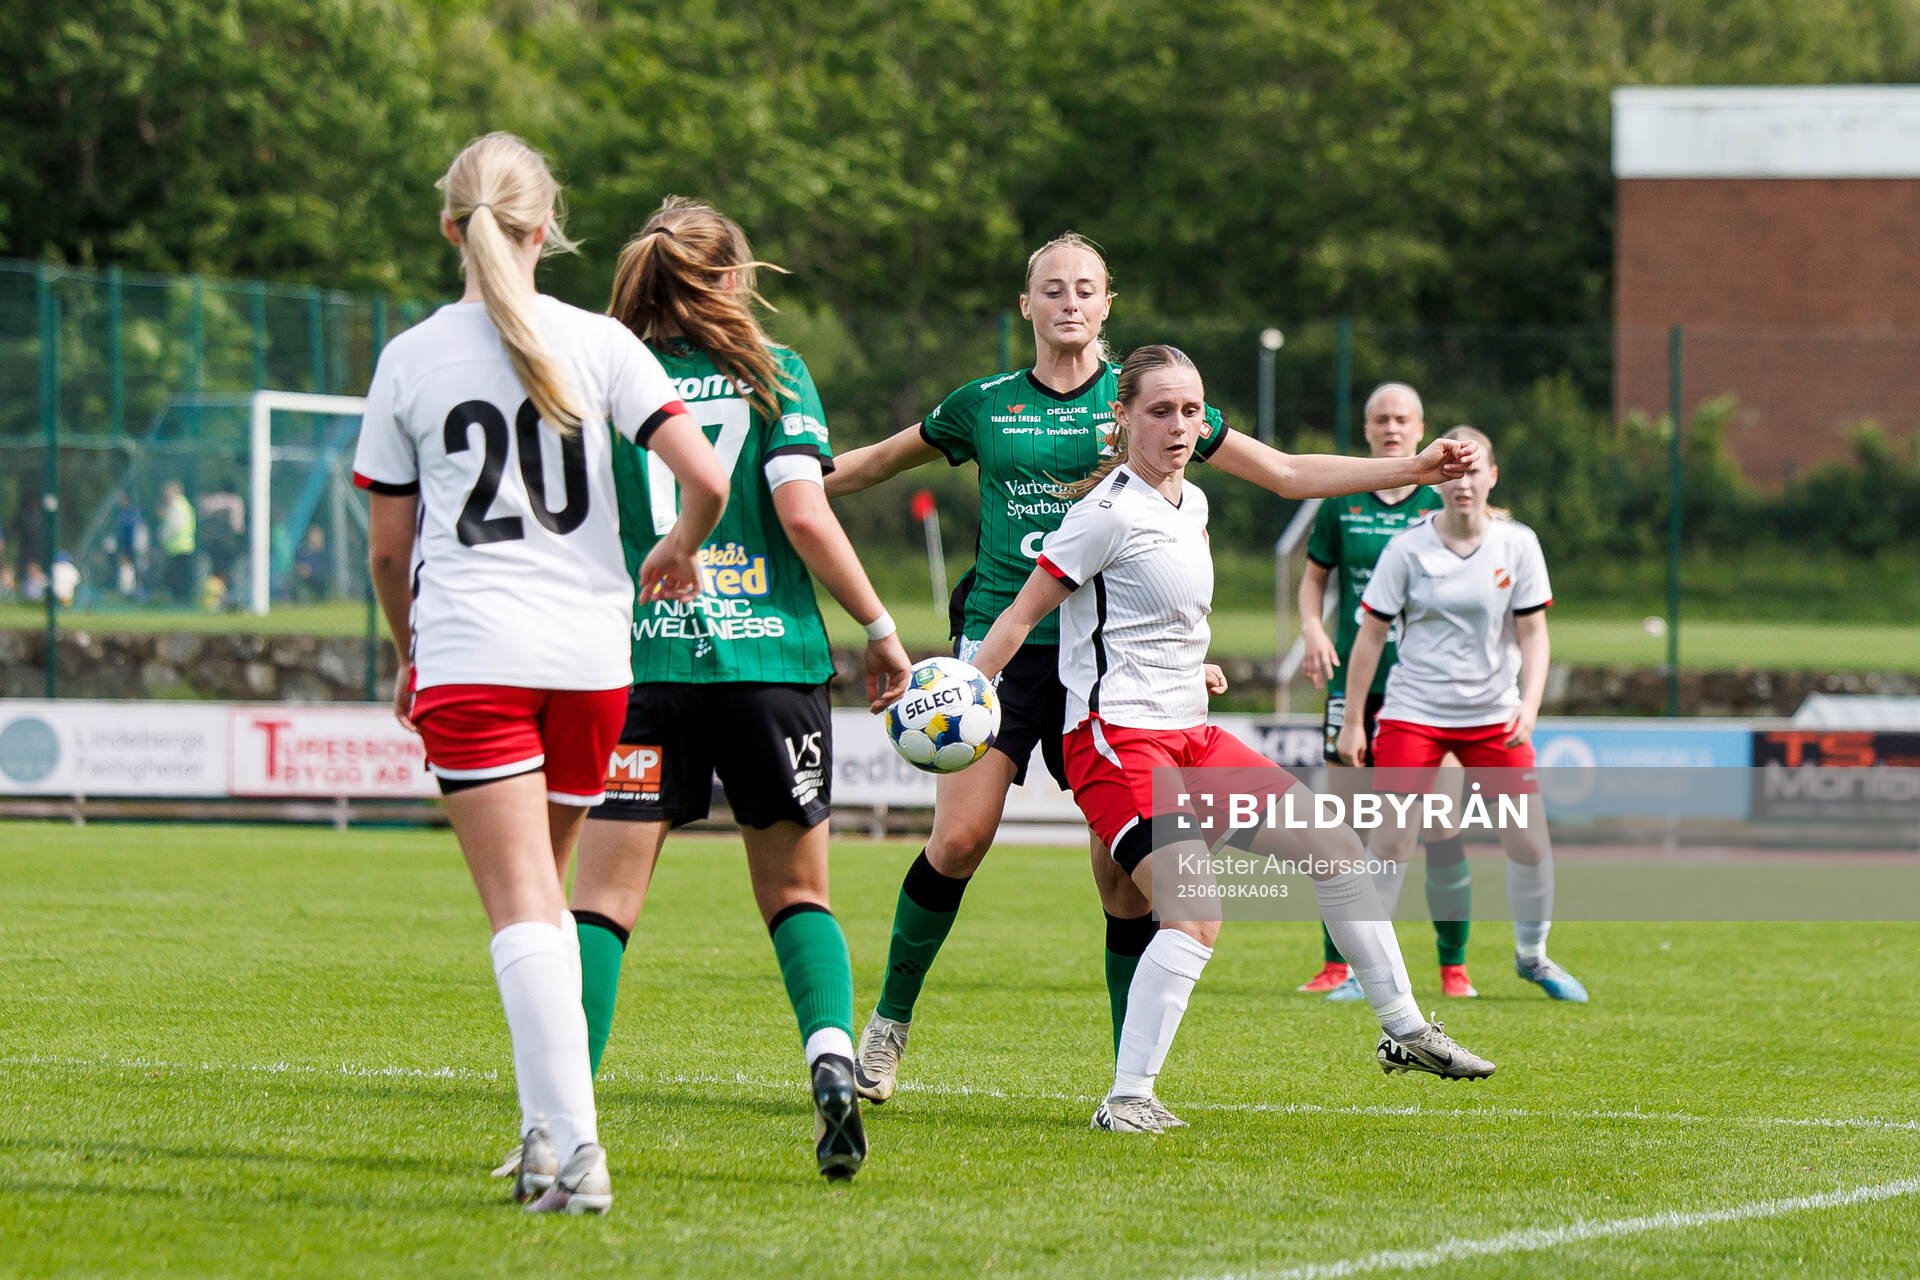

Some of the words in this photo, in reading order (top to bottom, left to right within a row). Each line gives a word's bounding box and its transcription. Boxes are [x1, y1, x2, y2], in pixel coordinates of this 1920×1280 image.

[670, 374, 754, 400] rome
[991, 415, 1016, 423] VARBERG
[1018, 415, 1041, 423] ENERGI
[1047, 407, 1088, 415] DELUXE
[1092, 411, 1117, 420] VARBE
[444, 398, 589, 547] 20
[698, 543, 748, 566] ekås
[702, 557, 768, 596] red
[655, 595, 752, 618] NORDIC
[633, 617, 785, 640] WELLNESS
[905, 687, 962, 720] SELECT
[784, 731, 821, 770] VS
[1767, 731, 1877, 767] TS
[376, 763, 412, 784] AB
[609, 749, 659, 779] MP
